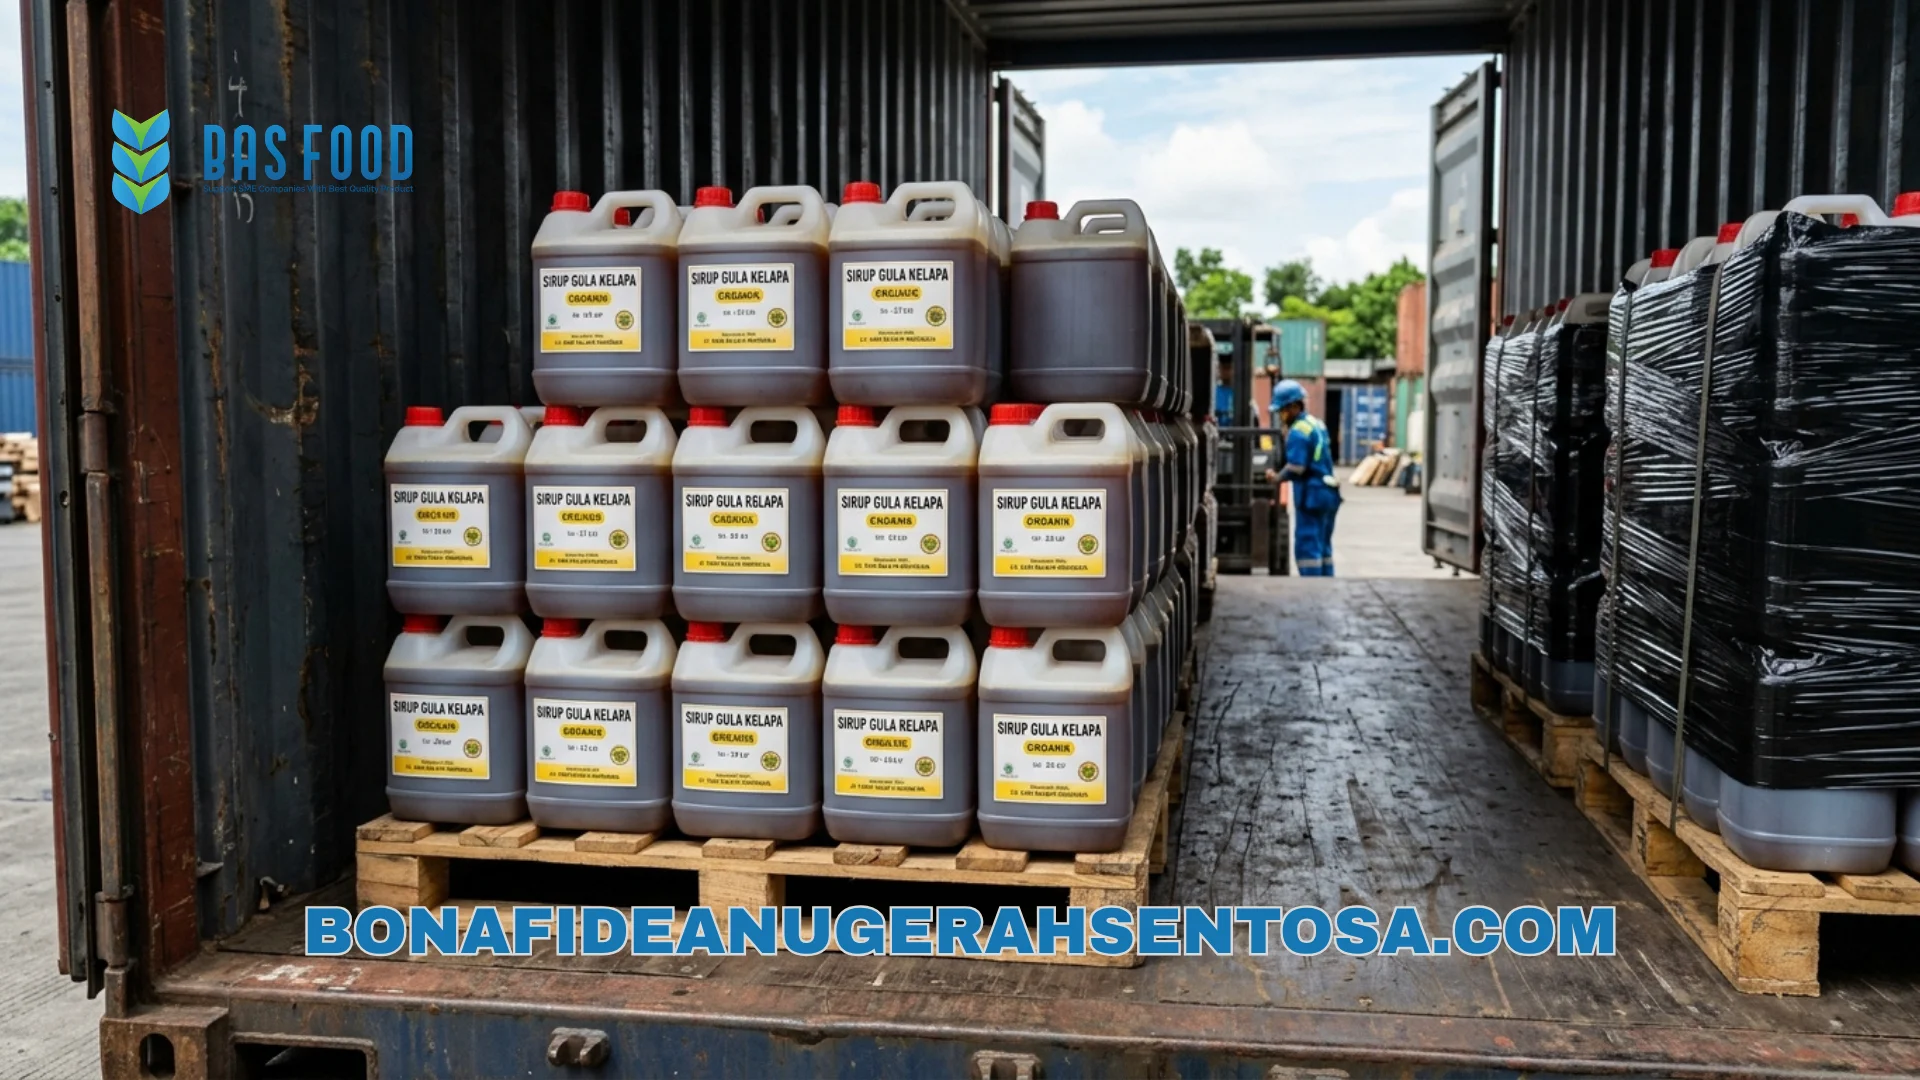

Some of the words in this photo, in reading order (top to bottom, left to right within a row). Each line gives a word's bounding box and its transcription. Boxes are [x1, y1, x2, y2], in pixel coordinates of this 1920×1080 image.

[543, 275, 569, 287] SIRUP
[600, 274, 636, 286] KELAPA
[691, 271, 718, 285] SIRUP
[722, 271, 748, 284] GULA
[751, 270, 790, 283] KELAPA
[846, 269, 876, 282] SIRUP
[878, 268, 906, 281] GULA
[421, 491, 445, 504] GULA
[536, 493, 563, 505] SIRUP
[566, 493, 590, 506] GULA
[594, 493, 631, 506] KELAPA
[686, 494, 714, 507] SIRUP
[716, 495, 742, 507] GULA
[842, 496, 871, 509] SIRUP
[874, 496, 901, 509] GULA
[997, 496, 1028, 509] SIRUP
[1030, 496, 1058, 509] GULA
[393, 700, 419, 713] SIRUP
[421, 702, 445, 714] GULA
[448, 703, 484, 716] KELAPA
[537, 705, 563, 719] SIRUP
[566, 707, 592, 720] GULA
[686, 711, 714, 724] SIRUP
[716, 713, 743, 726] GULA
[745, 714, 783, 727] KELAPA
[838, 716, 866, 730] SIRUP
[869, 718, 896, 731] GULA
[998, 721, 1028, 734] SIRUP
[1031, 723, 1059, 736] GULA
[1062, 724, 1102, 736] KELAPA
